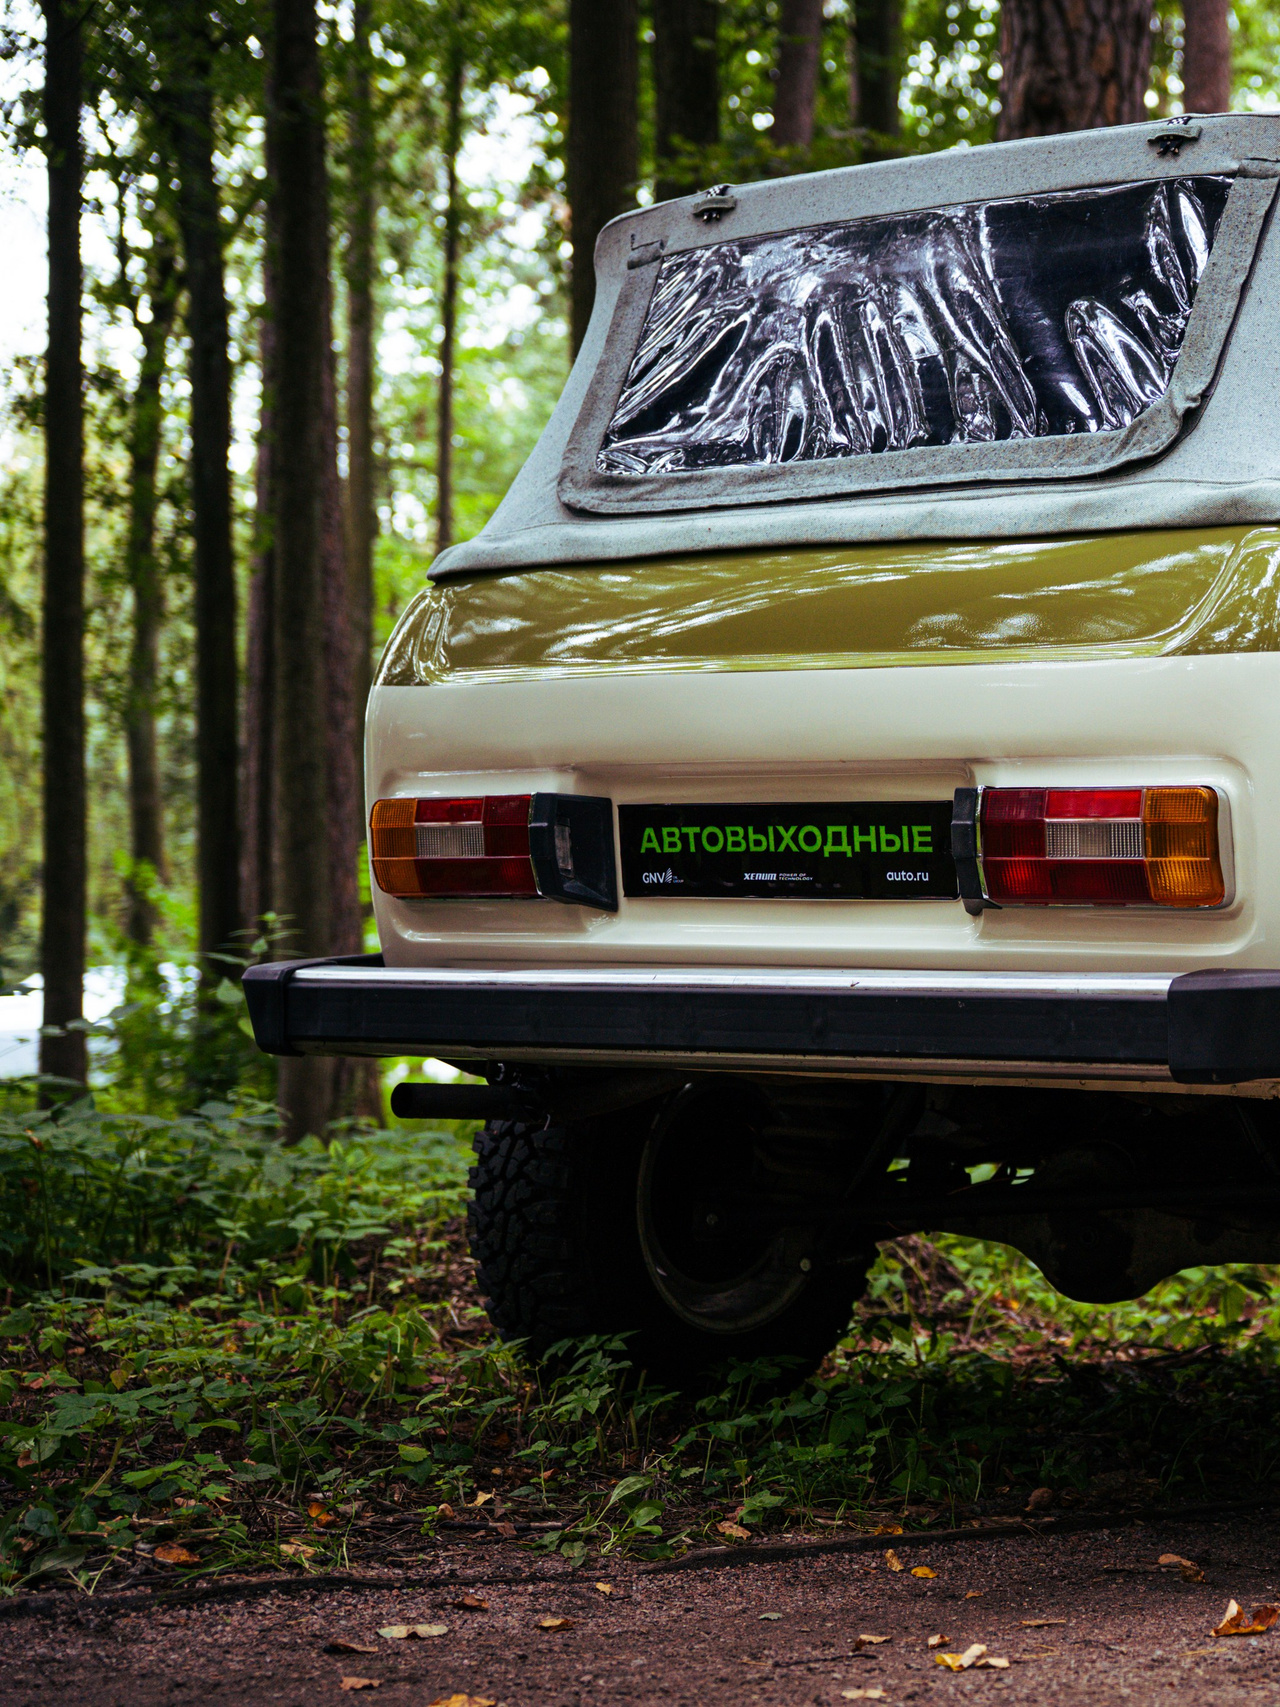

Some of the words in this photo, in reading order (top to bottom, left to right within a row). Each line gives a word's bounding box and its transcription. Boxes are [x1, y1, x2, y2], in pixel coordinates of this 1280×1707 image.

[640, 825, 933, 858] АВТОВЫХОДНЫЕ
[642, 872, 665, 884] GNV
[743, 872, 778, 881] XENUM
[886, 870, 929, 882] auto.ru
